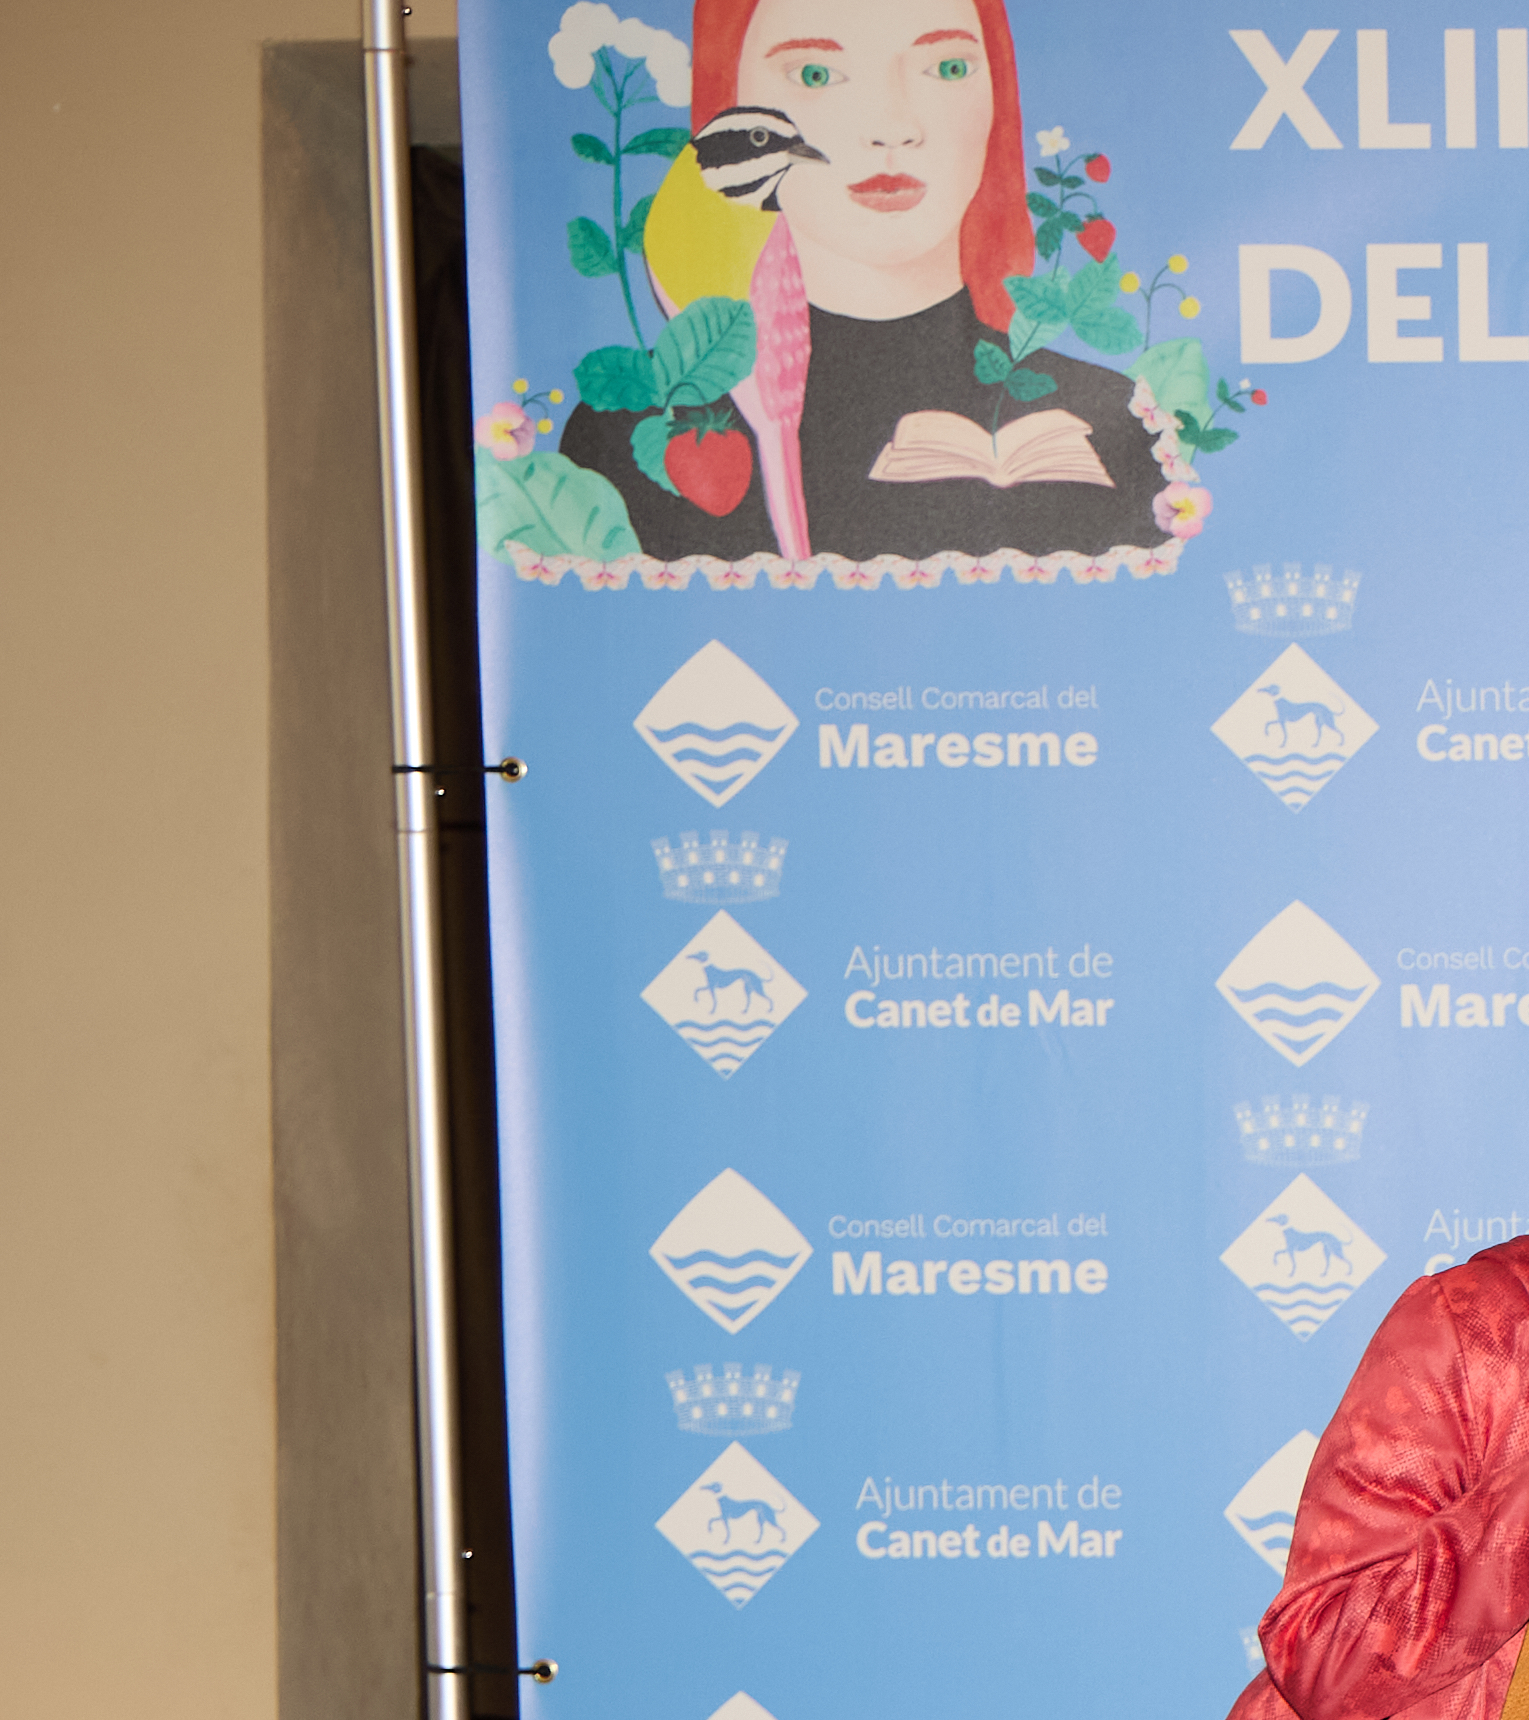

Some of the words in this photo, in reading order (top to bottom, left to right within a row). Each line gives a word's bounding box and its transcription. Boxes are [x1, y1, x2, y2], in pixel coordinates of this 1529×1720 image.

[1229, 28, 1529, 150] XLII
[814, 685, 915, 712] Consell
[920, 684, 1050, 710] Comarcal
[1057, 685, 1099, 709] del
[818, 723, 1099, 769] Maresme
[843, 945, 1060, 988] Ajuntament
[1068, 943, 1114, 978] de
[1397, 947, 1495, 971] Consell
[844, 989, 971, 1029] Canet
[976, 993, 1022, 1028] de
[1028, 989, 1115, 1027] Mar
[827, 1213, 927, 1239] Consell
[932, 1212, 1061, 1239] Comarcal
[1067, 1212, 1108, 1237] del
[832, 1250, 1109, 1296] Maresme
[855, 1476, 1069, 1519] Ajuntament
[1077, 1475, 1123, 1510] de
[856, 1520, 981, 1559] Canet
[986, 1525, 1032, 1558] de
[1037, 1520, 1123, 1558] Mar
